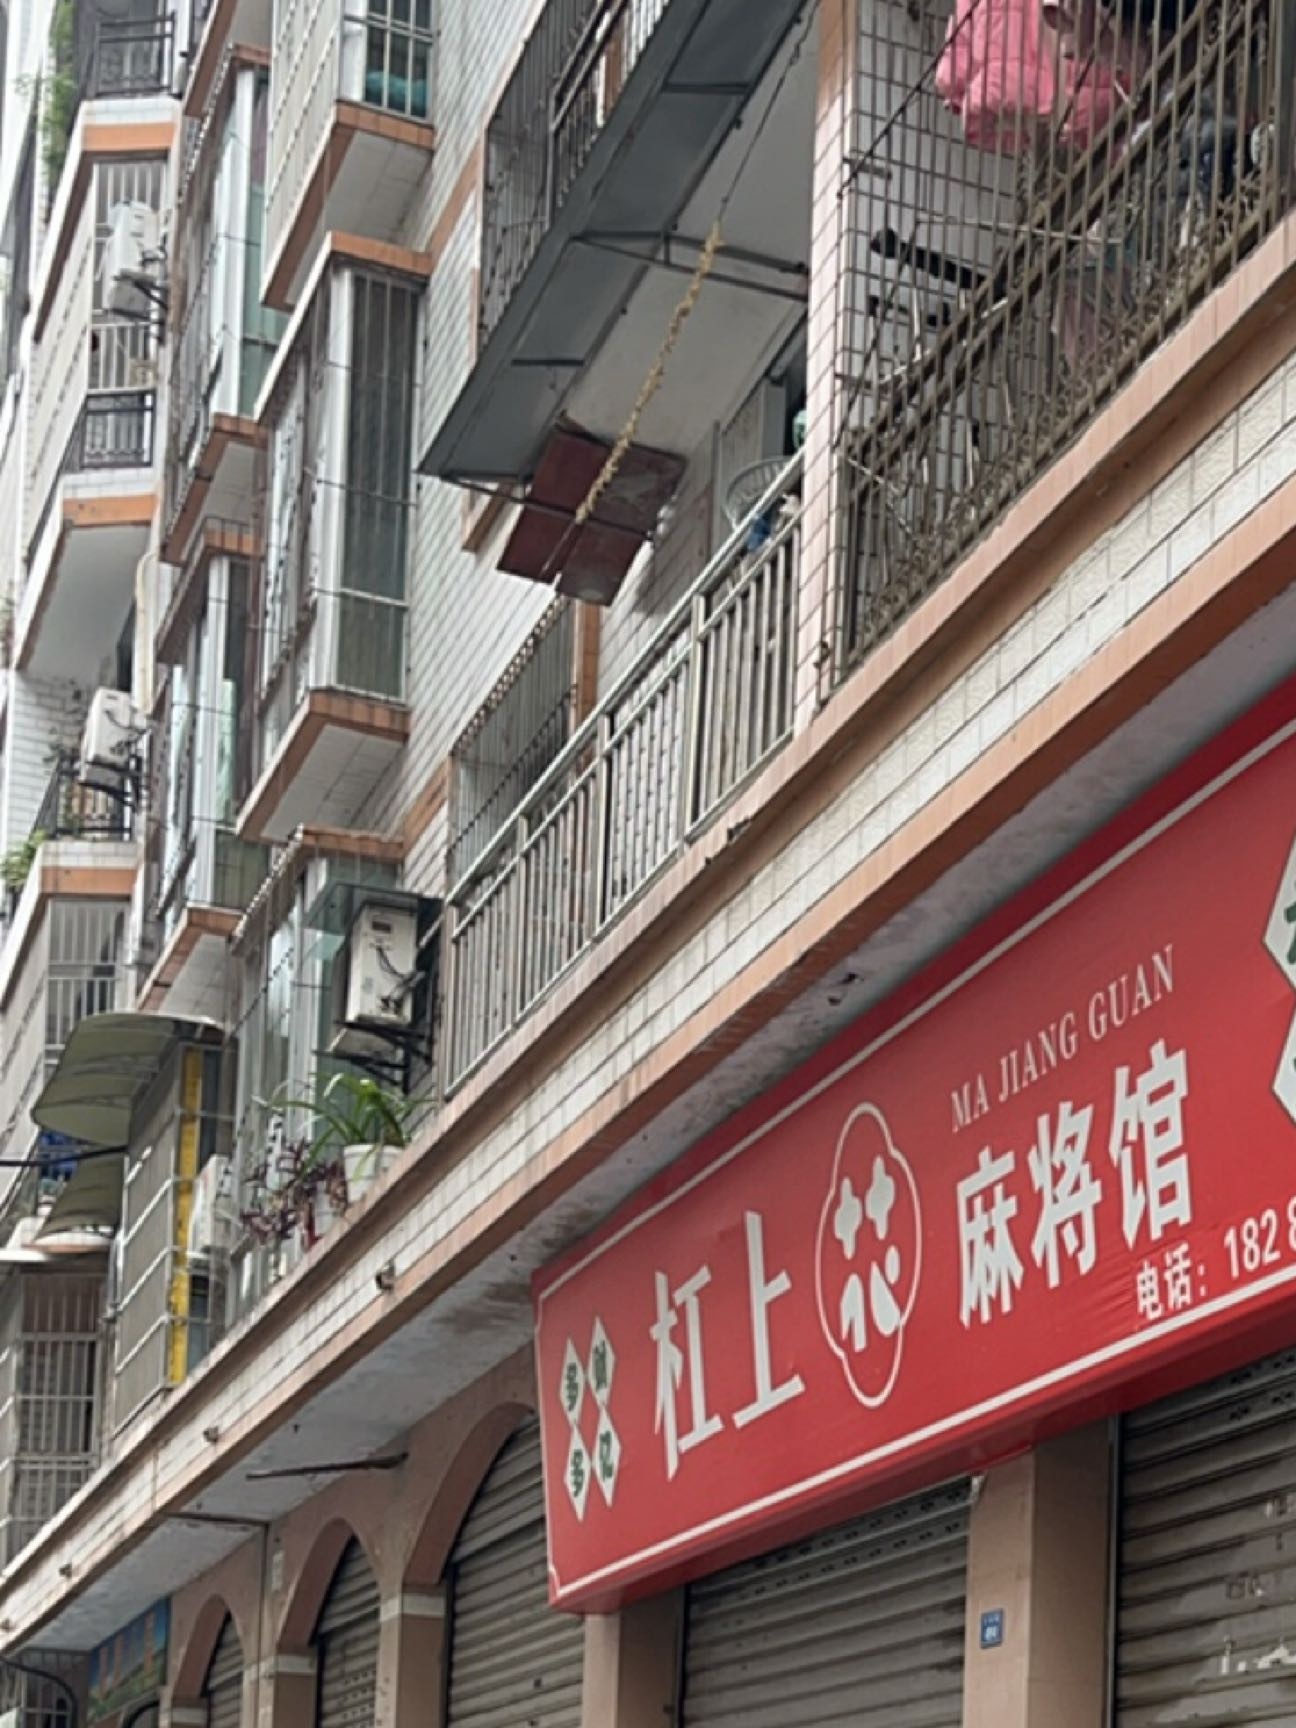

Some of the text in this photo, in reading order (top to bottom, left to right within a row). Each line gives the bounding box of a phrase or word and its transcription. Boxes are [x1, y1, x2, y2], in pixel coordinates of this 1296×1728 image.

[951, 943, 1175, 1134] MA JIANG GUAN
[956, 1038, 1193, 1330] 麻将馆
[1223, 1208, 1281, 1280] 182
